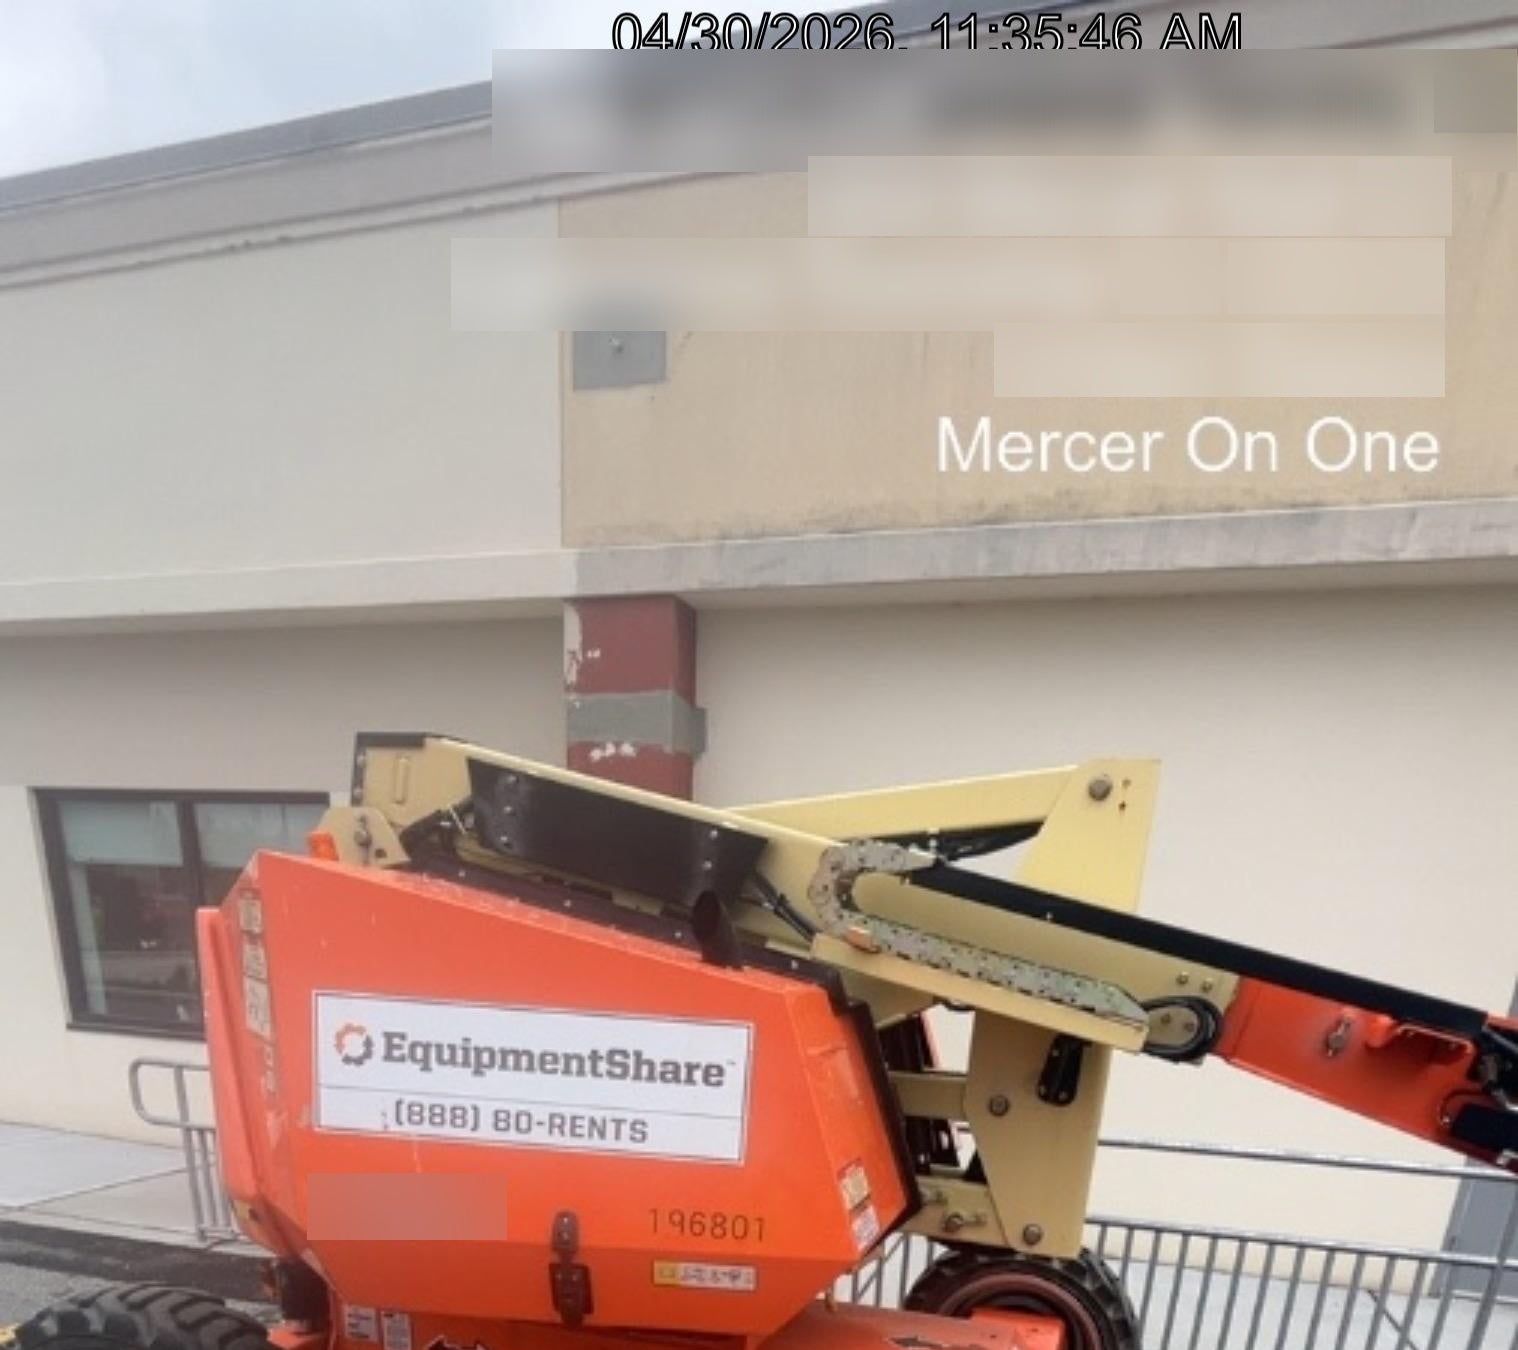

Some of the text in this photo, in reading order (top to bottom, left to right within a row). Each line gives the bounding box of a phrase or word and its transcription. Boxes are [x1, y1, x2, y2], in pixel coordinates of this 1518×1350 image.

[382, 1031, 725, 1088] EquipmentShare
[395, 1100, 649, 1144] (888) 80-RENTS
[649, 1208, 766, 1243] 196801
